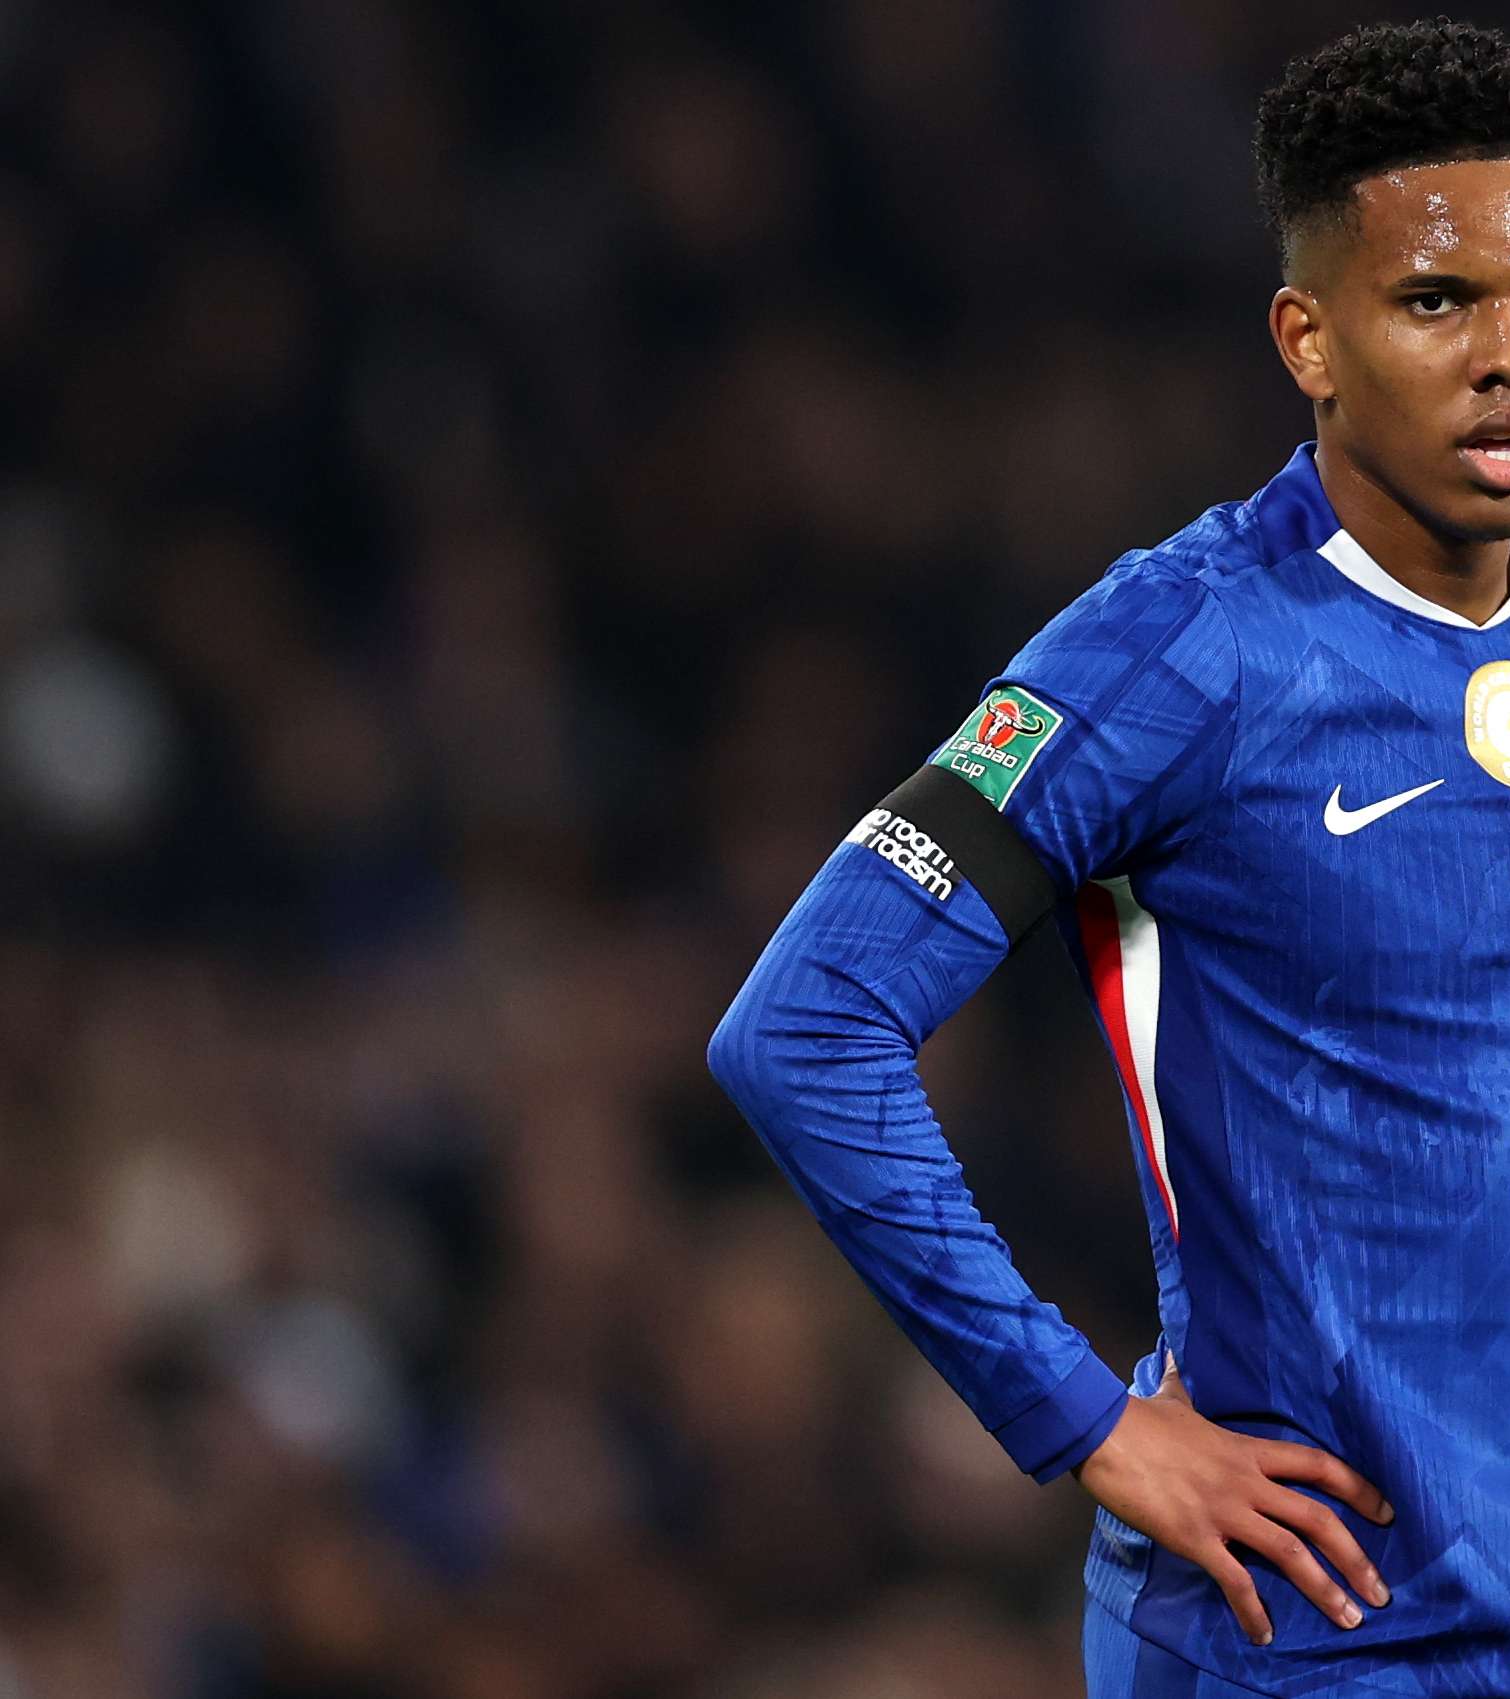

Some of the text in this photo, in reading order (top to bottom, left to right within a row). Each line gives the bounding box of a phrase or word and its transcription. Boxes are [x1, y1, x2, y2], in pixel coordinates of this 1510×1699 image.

[950, 737, 1018, 769] Carabao
[951, 753, 986, 779] Cup
[868, 832, 952, 901] racism
